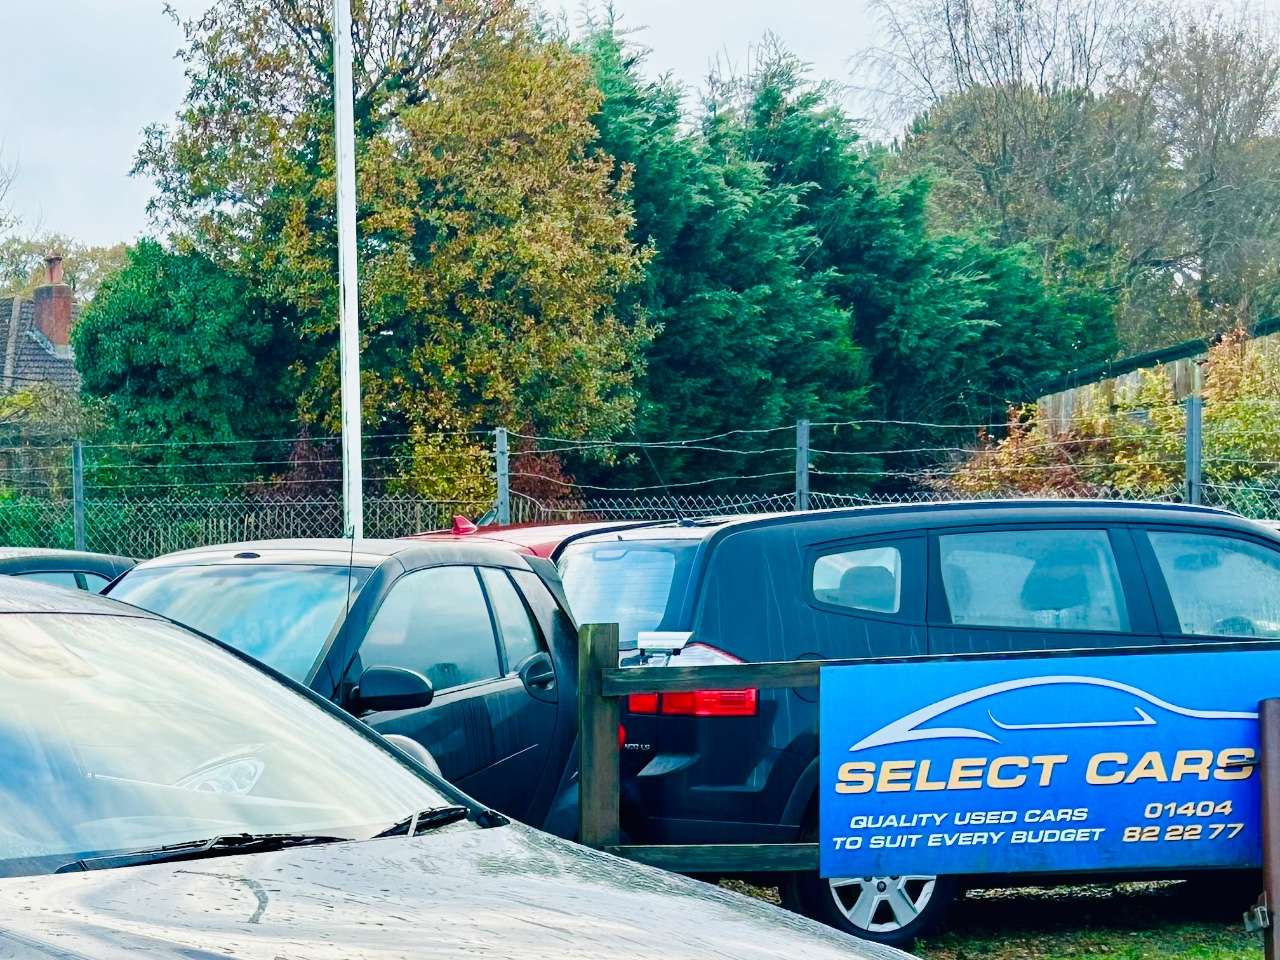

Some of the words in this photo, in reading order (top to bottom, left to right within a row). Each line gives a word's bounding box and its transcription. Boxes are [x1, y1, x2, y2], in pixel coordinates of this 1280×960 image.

[834, 754, 1069, 795] SELECT
[1085, 747, 1257, 786] CARS
[849, 812, 949, 829] QUALITY
[953, 809, 1018, 825] USED
[1023, 807, 1089, 823] CARS
[1143, 800, 1233, 819] 01404
[832, 836, 863, 850] TO
[868, 833, 923, 849] SUIT
[926, 830, 1007, 847] EVERY
[1009, 827, 1106, 844] BUDGET
[1121, 825, 1161, 842] 82
[1163, 824, 1203, 841] 22
[1207, 822, 1245, 840] 77
